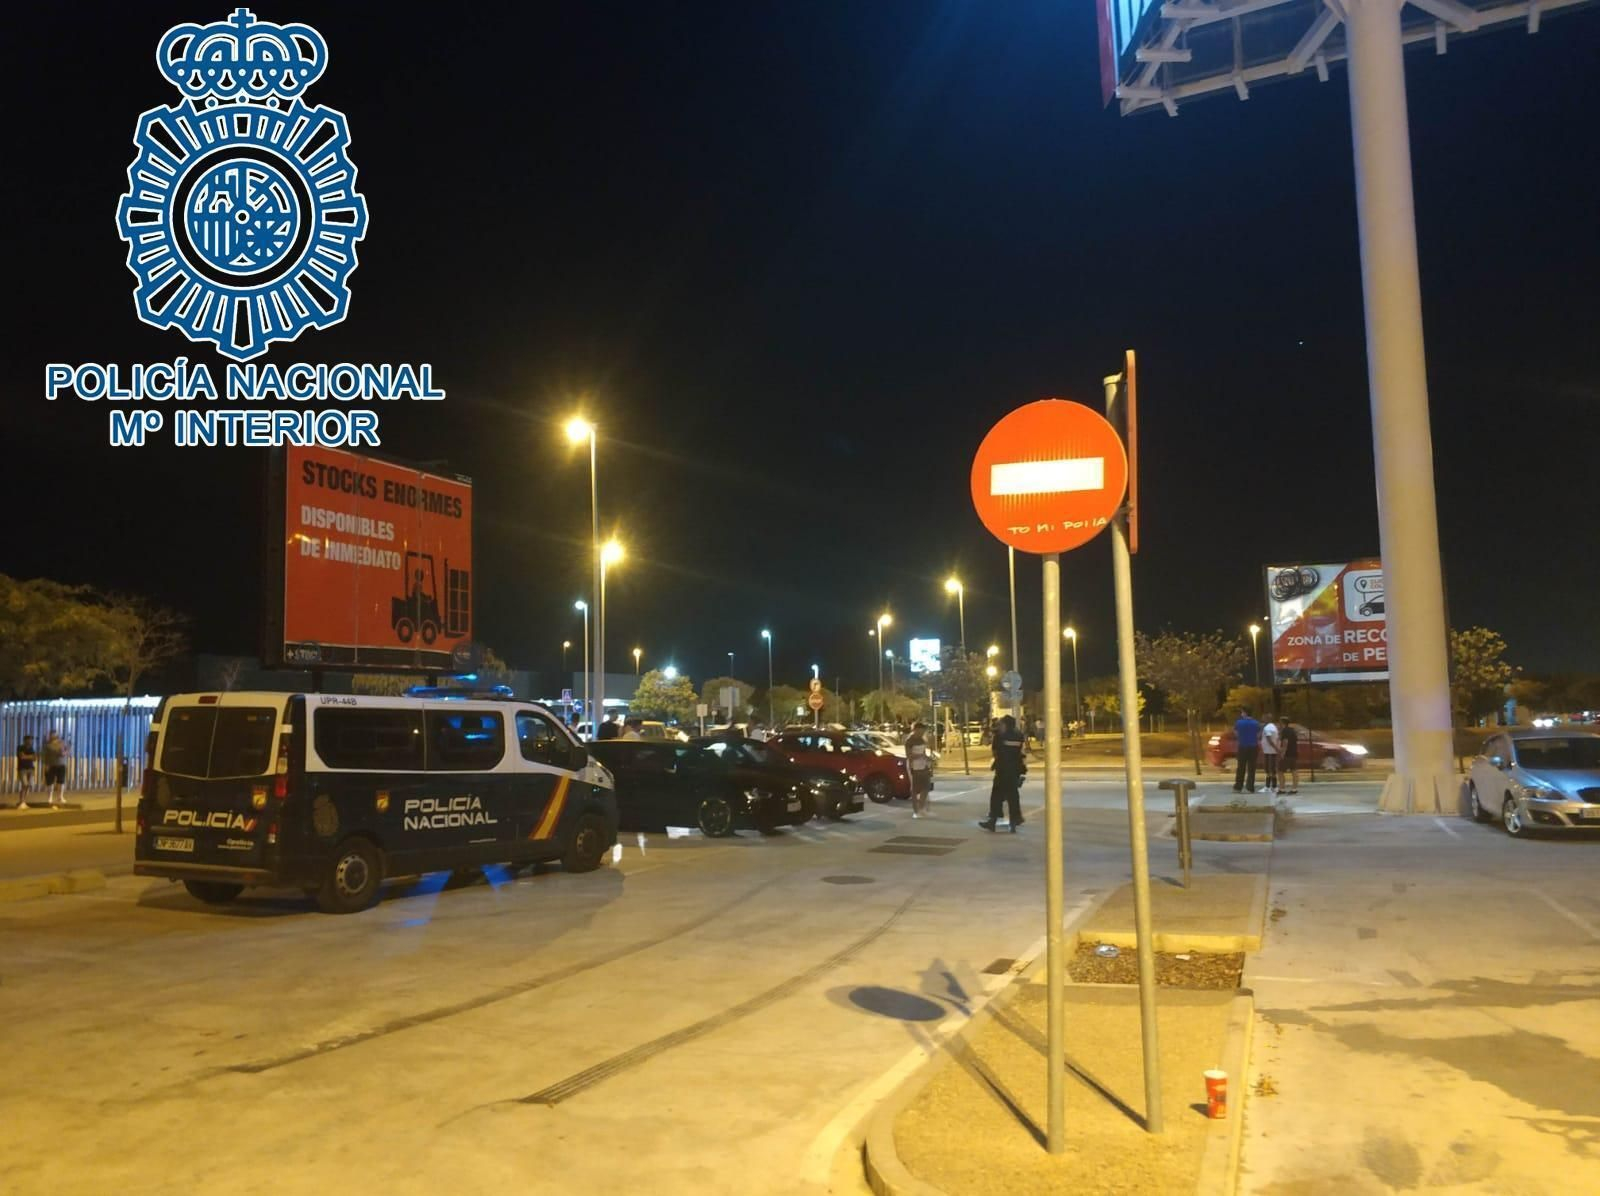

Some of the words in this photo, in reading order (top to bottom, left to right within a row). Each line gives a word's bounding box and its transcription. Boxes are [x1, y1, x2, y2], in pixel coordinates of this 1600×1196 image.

[303, 460, 377, 499] STOCKS
[384, 479, 462, 519] ENORMES
[301, 505, 395, 541] DISPONIBLES
[1007, 526, 1030, 535] TO
[300, 538, 321, 559] DE
[325, 541, 401, 570] INMEDIATO
[1287, 636, 1322, 646] ZONA
[1325, 635, 1341, 645] DE
[1343, 652, 1359, 662] DE
[403, 793, 482, 814] POLICÍA
[163, 809, 246, 829] POLICÍA
[403, 811, 498, 831] NACIONAL
